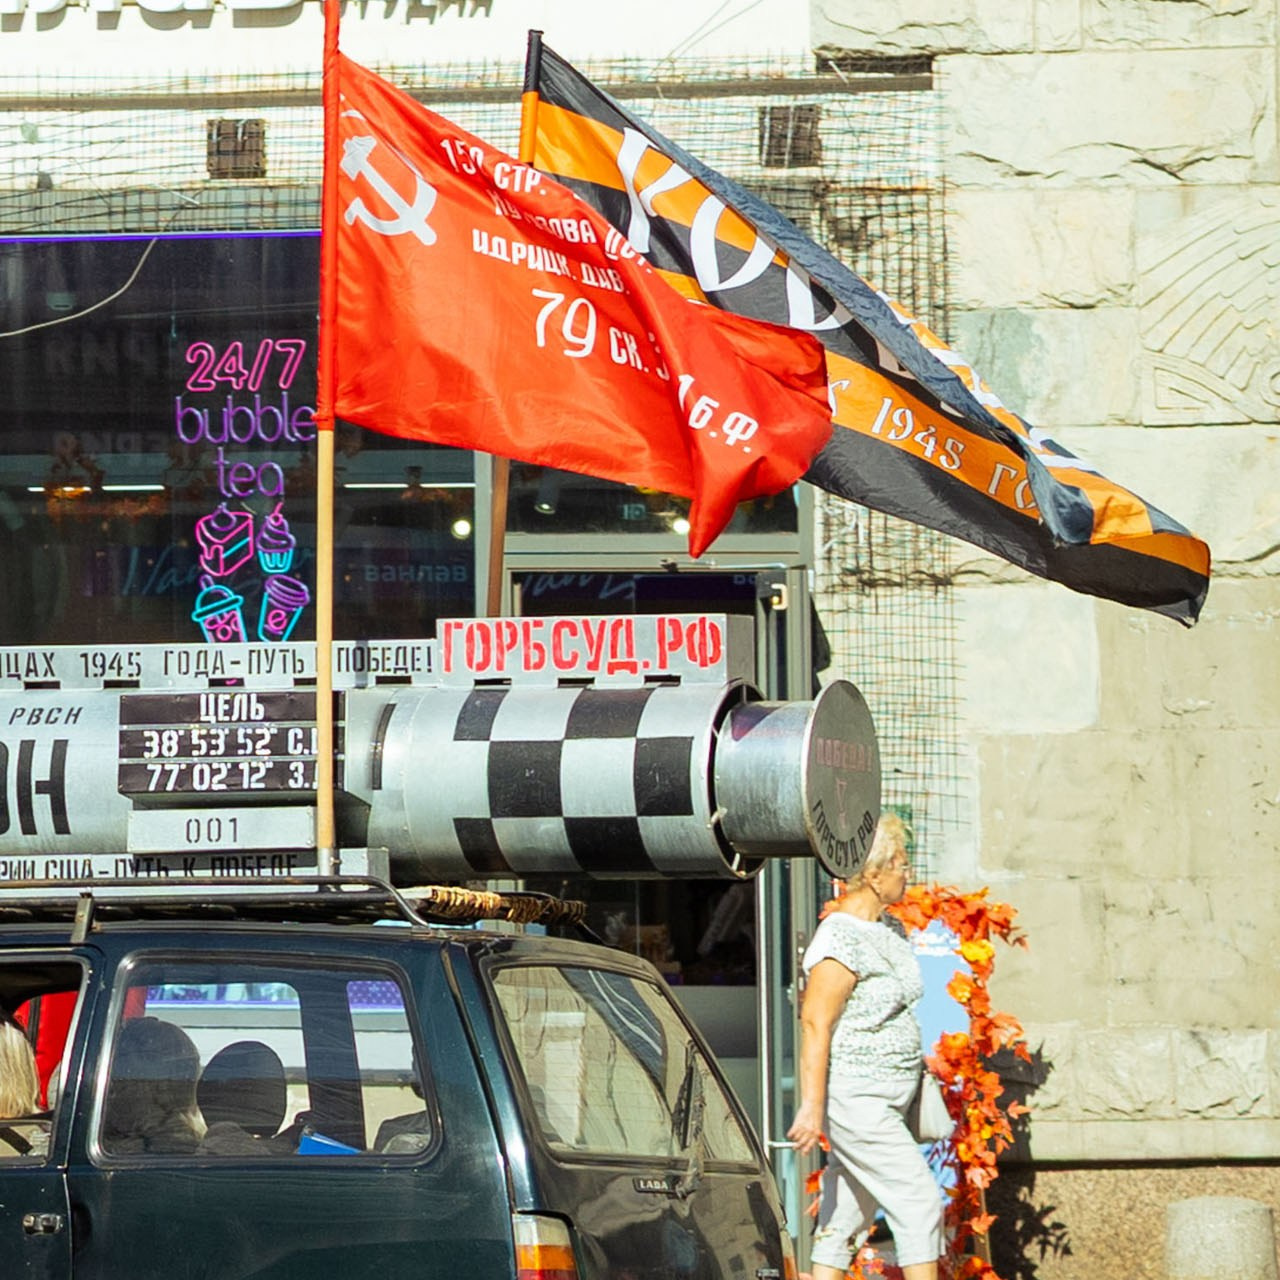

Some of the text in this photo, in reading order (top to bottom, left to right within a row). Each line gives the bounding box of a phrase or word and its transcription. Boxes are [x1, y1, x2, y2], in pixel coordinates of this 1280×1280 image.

[494, 162, 547, 195] СТР.
[531, 288, 597, 357] 79
[186, 338, 306, 392] 24/7
[176, 391, 316, 444] bubble
[871, 396, 965, 471] 1945
[213, 447, 284, 498] tea
[79, 651, 142, 678] 1945
[337, 645, 433, 675] ПОБЕДЕ!
[443, 616, 722, 675] ГОРБСУД.РФ
[8, 706, 84, 726] РВСН
[199, 693, 266, 723] ЦЕЛЬ
[186, 817, 237, 844] 001
[812, 799, 874, 869] ГОРБСУД.РФ
[183, 856, 195, 877] К
[639, 1179, 669, 1190] LADA
